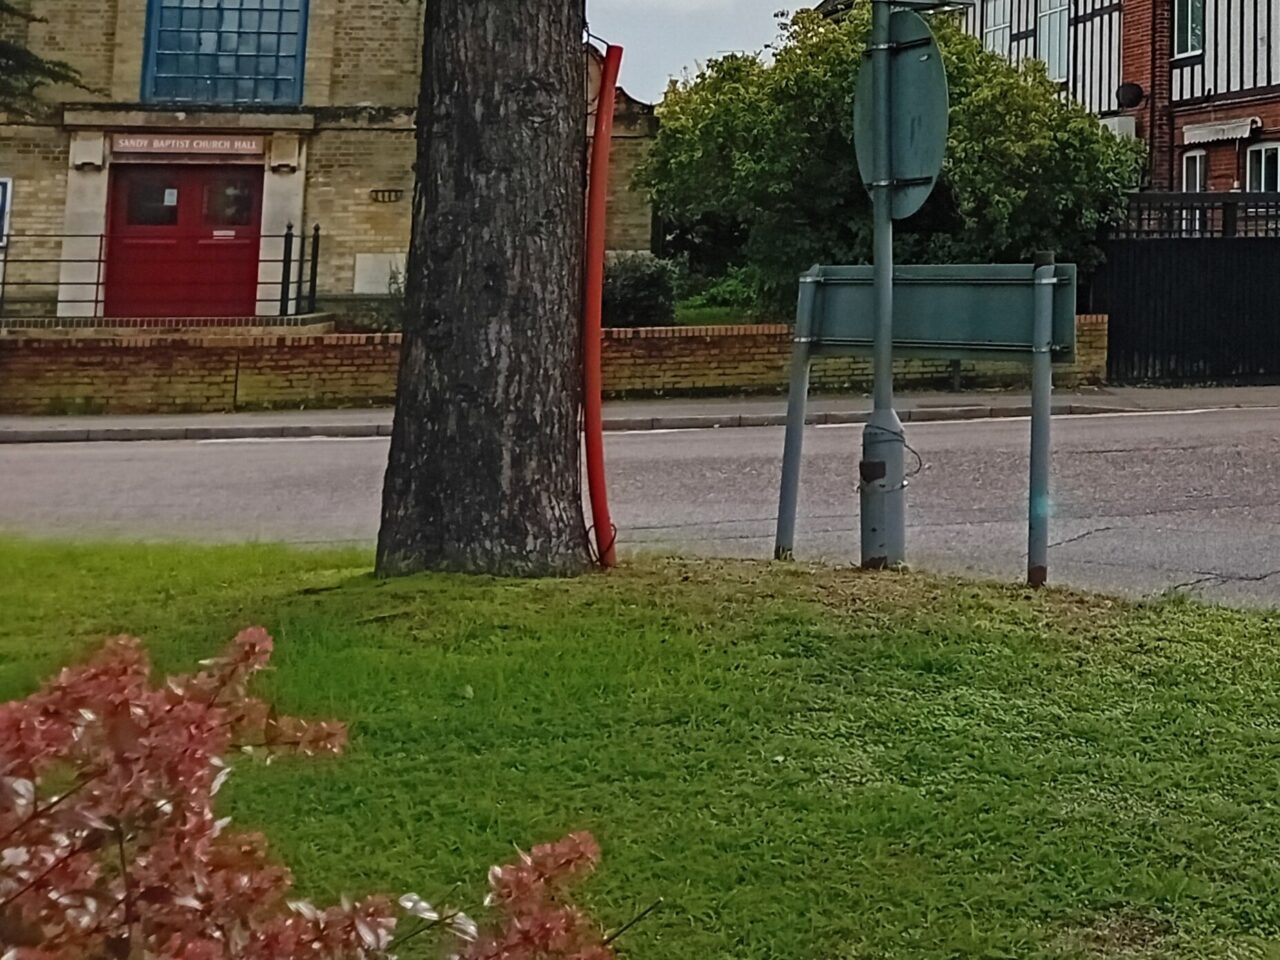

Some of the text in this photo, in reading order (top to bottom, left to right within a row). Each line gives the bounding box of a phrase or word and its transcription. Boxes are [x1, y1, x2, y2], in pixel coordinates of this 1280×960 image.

[118, 139, 256, 149] SANDY BAPTIST CHURCH HALL
